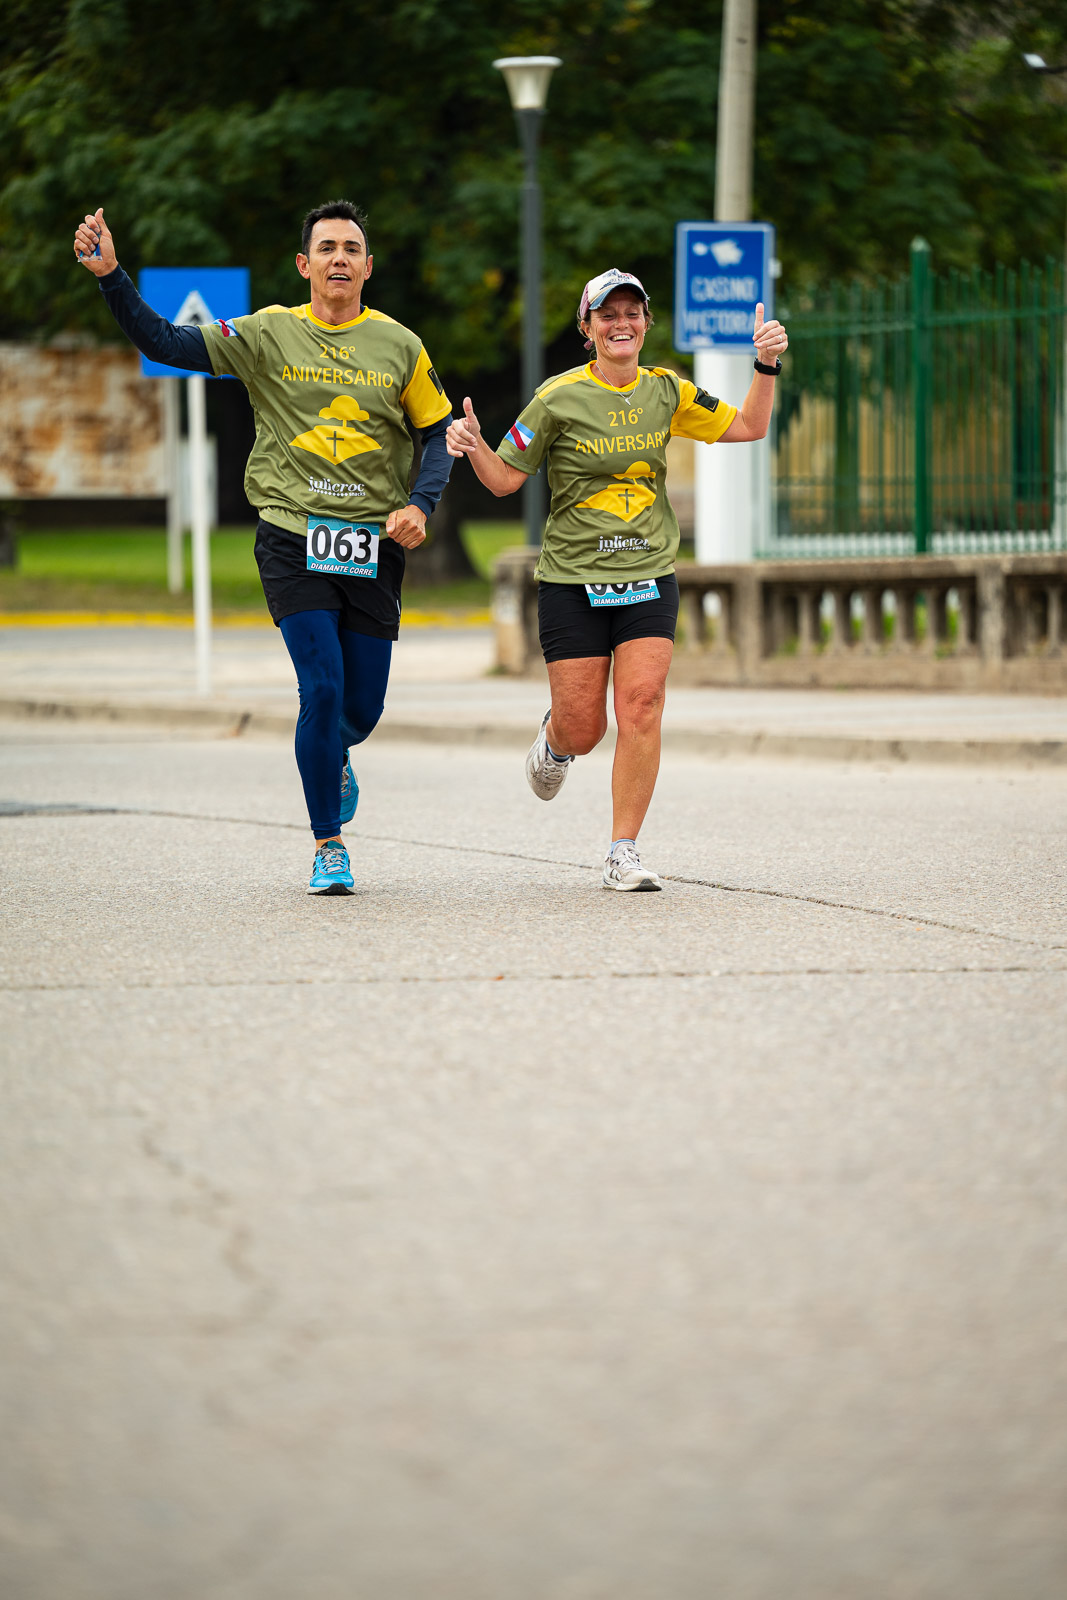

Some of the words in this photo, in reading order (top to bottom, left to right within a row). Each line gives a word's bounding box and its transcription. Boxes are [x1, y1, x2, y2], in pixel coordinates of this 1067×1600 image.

[691, 276, 758, 302] CASINO
[320, 344, 356, 360] 216°
[281, 365, 394, 388] ANIVERSARIO
[607, 407, 644, 427] 216°
[575, 430, 669, 455] ANIVERSAR
[308, 476, 365, 493] julicroc
[311, 524, 372, 566] 063
[310, 562, 349, 573] DIAMANTE
[349, 566, 374, 576] CORRE
[593, 596, 629, 605] DIAMANTE
[630, 591, 656, 602] CORRE
